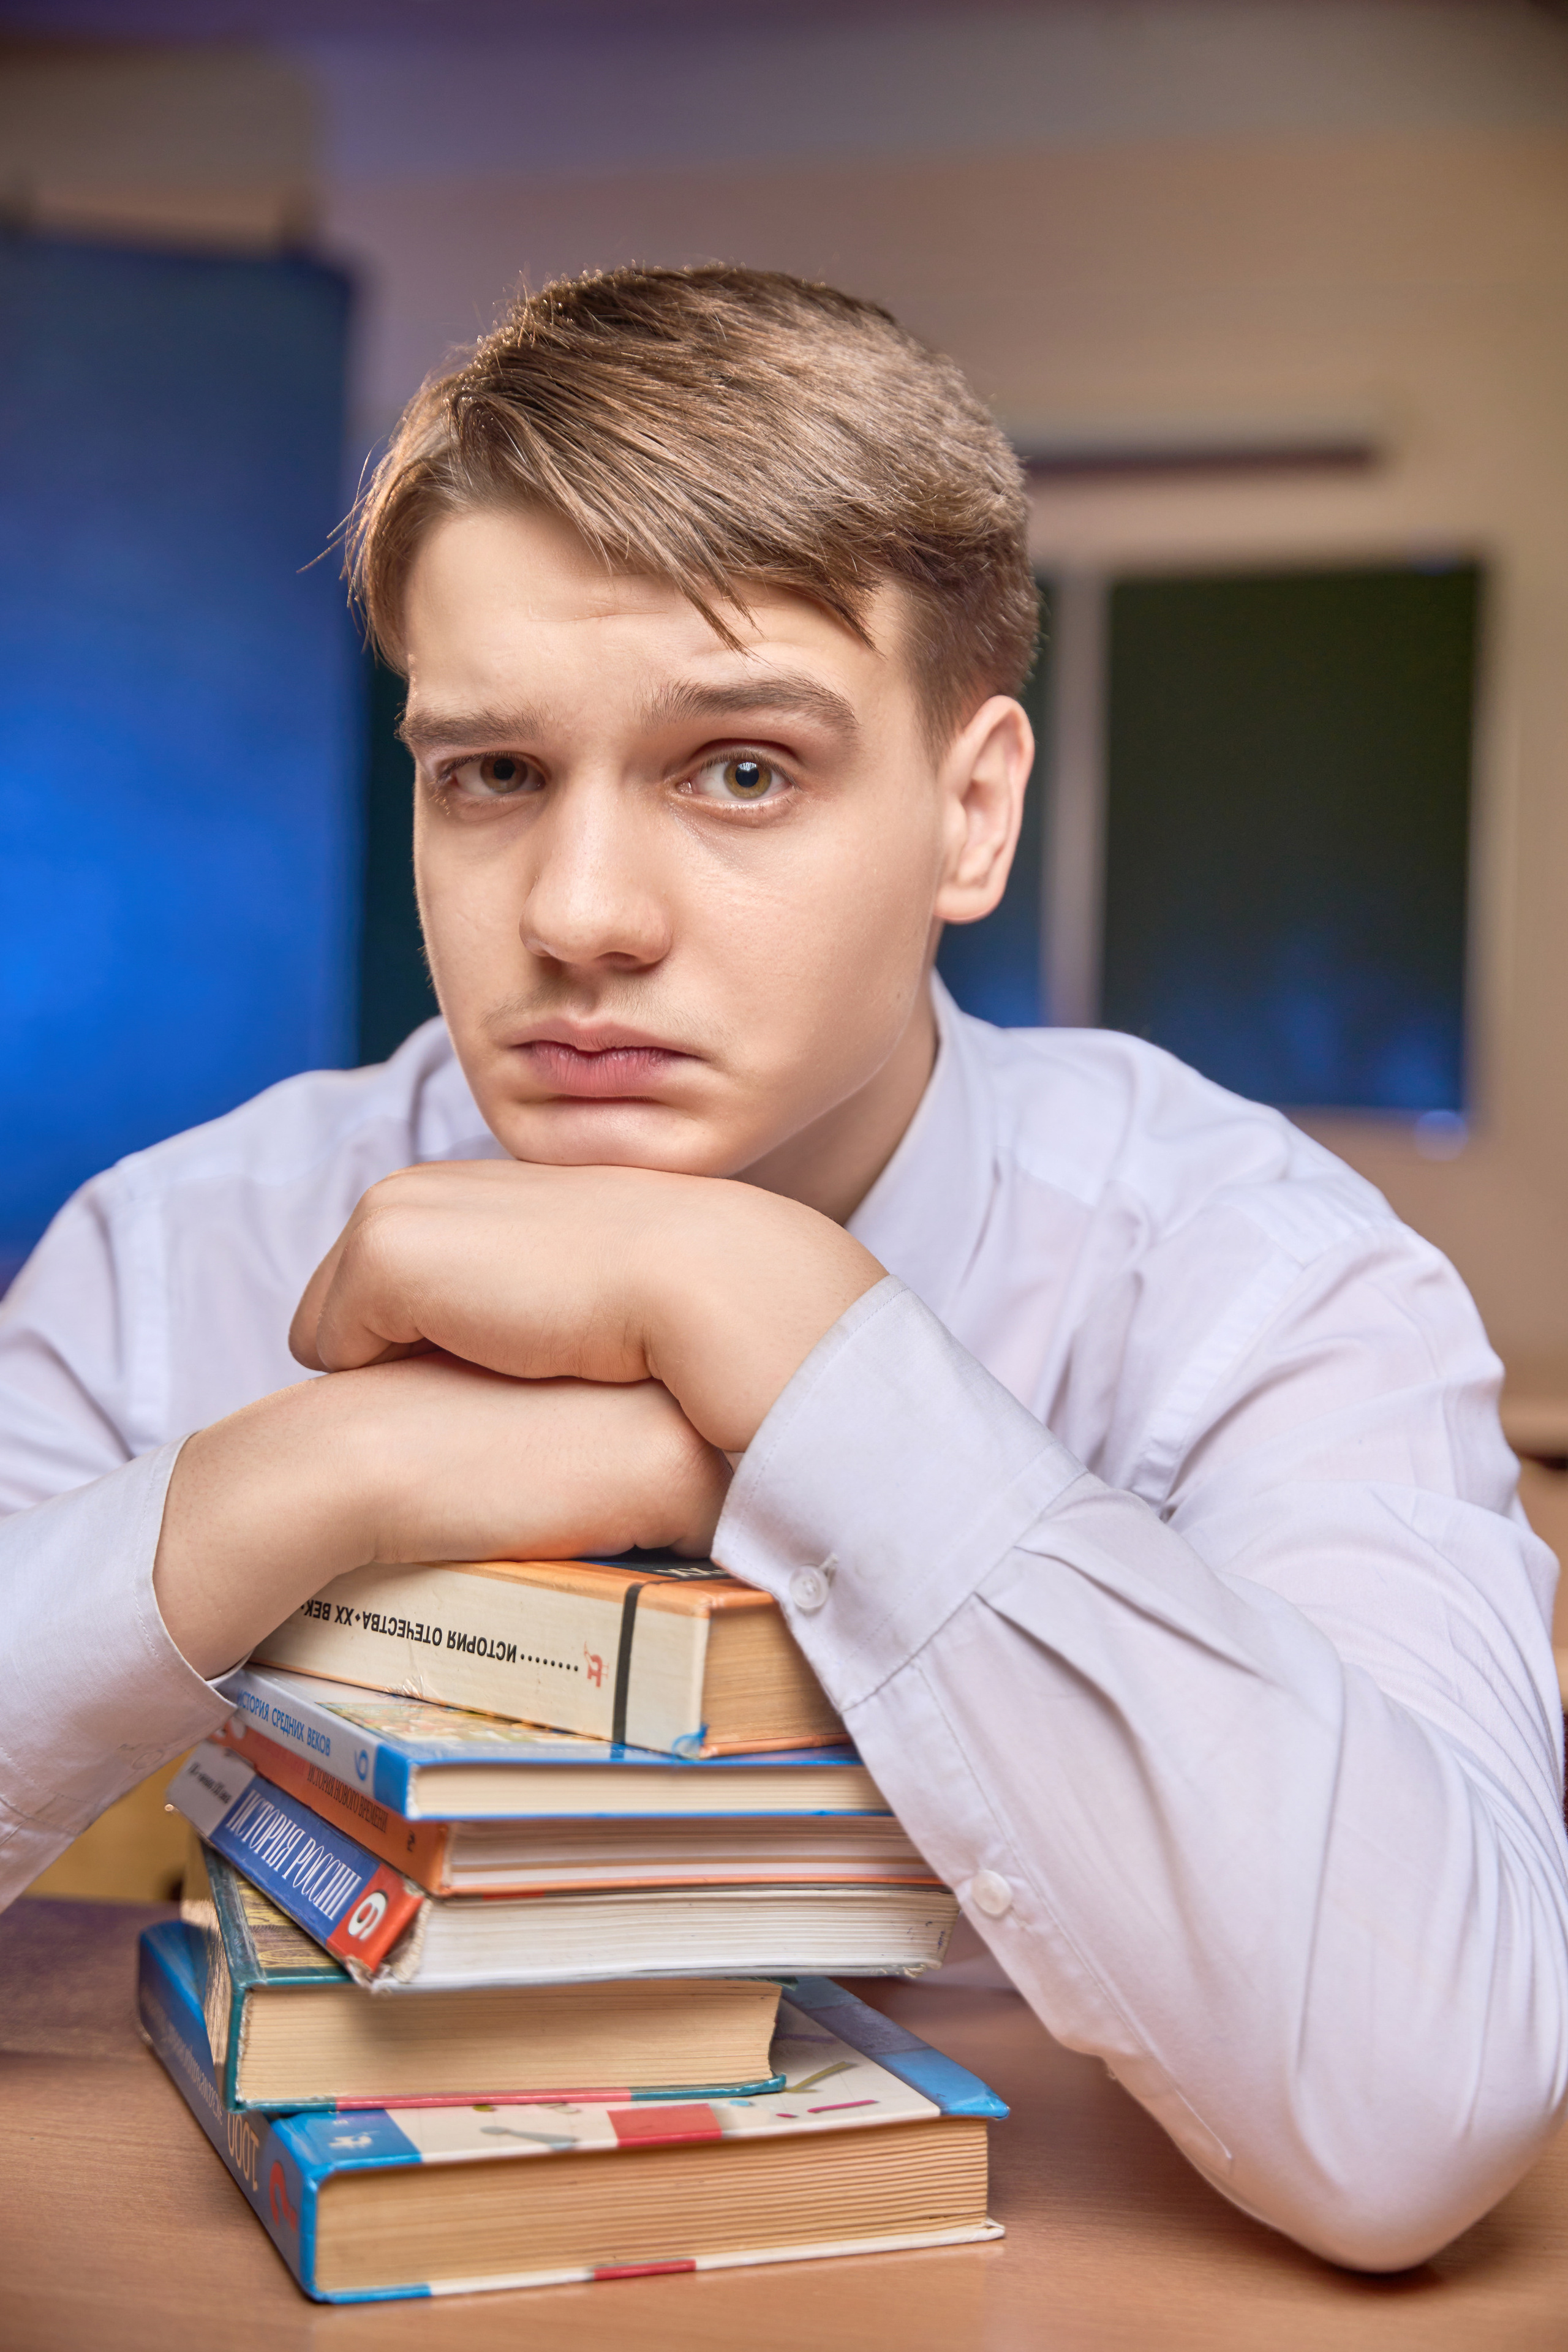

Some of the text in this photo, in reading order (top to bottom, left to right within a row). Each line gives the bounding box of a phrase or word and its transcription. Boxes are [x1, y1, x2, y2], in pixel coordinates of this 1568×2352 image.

[304, 1599, 331, 1621] ВЕК
[363, 1611, 442, 1646] ОТЕЧЕСТВА
[447, 1631, 518, 1663] ИСТОРИЯ
[237, 1691, 270, 1722] ИСТОРИЯ
[272, 1707, 304, 1742] СРЕДНИХ
[307, 1727, 331, 1757] ВЕКОВ
[307, 1764, 334, 1797] ИСТОРИЯ
[334, 1779, 360, 1814] НОВОГО
[226, 1790, 362, 1921] ИСТОРИЯ РОССИИ
